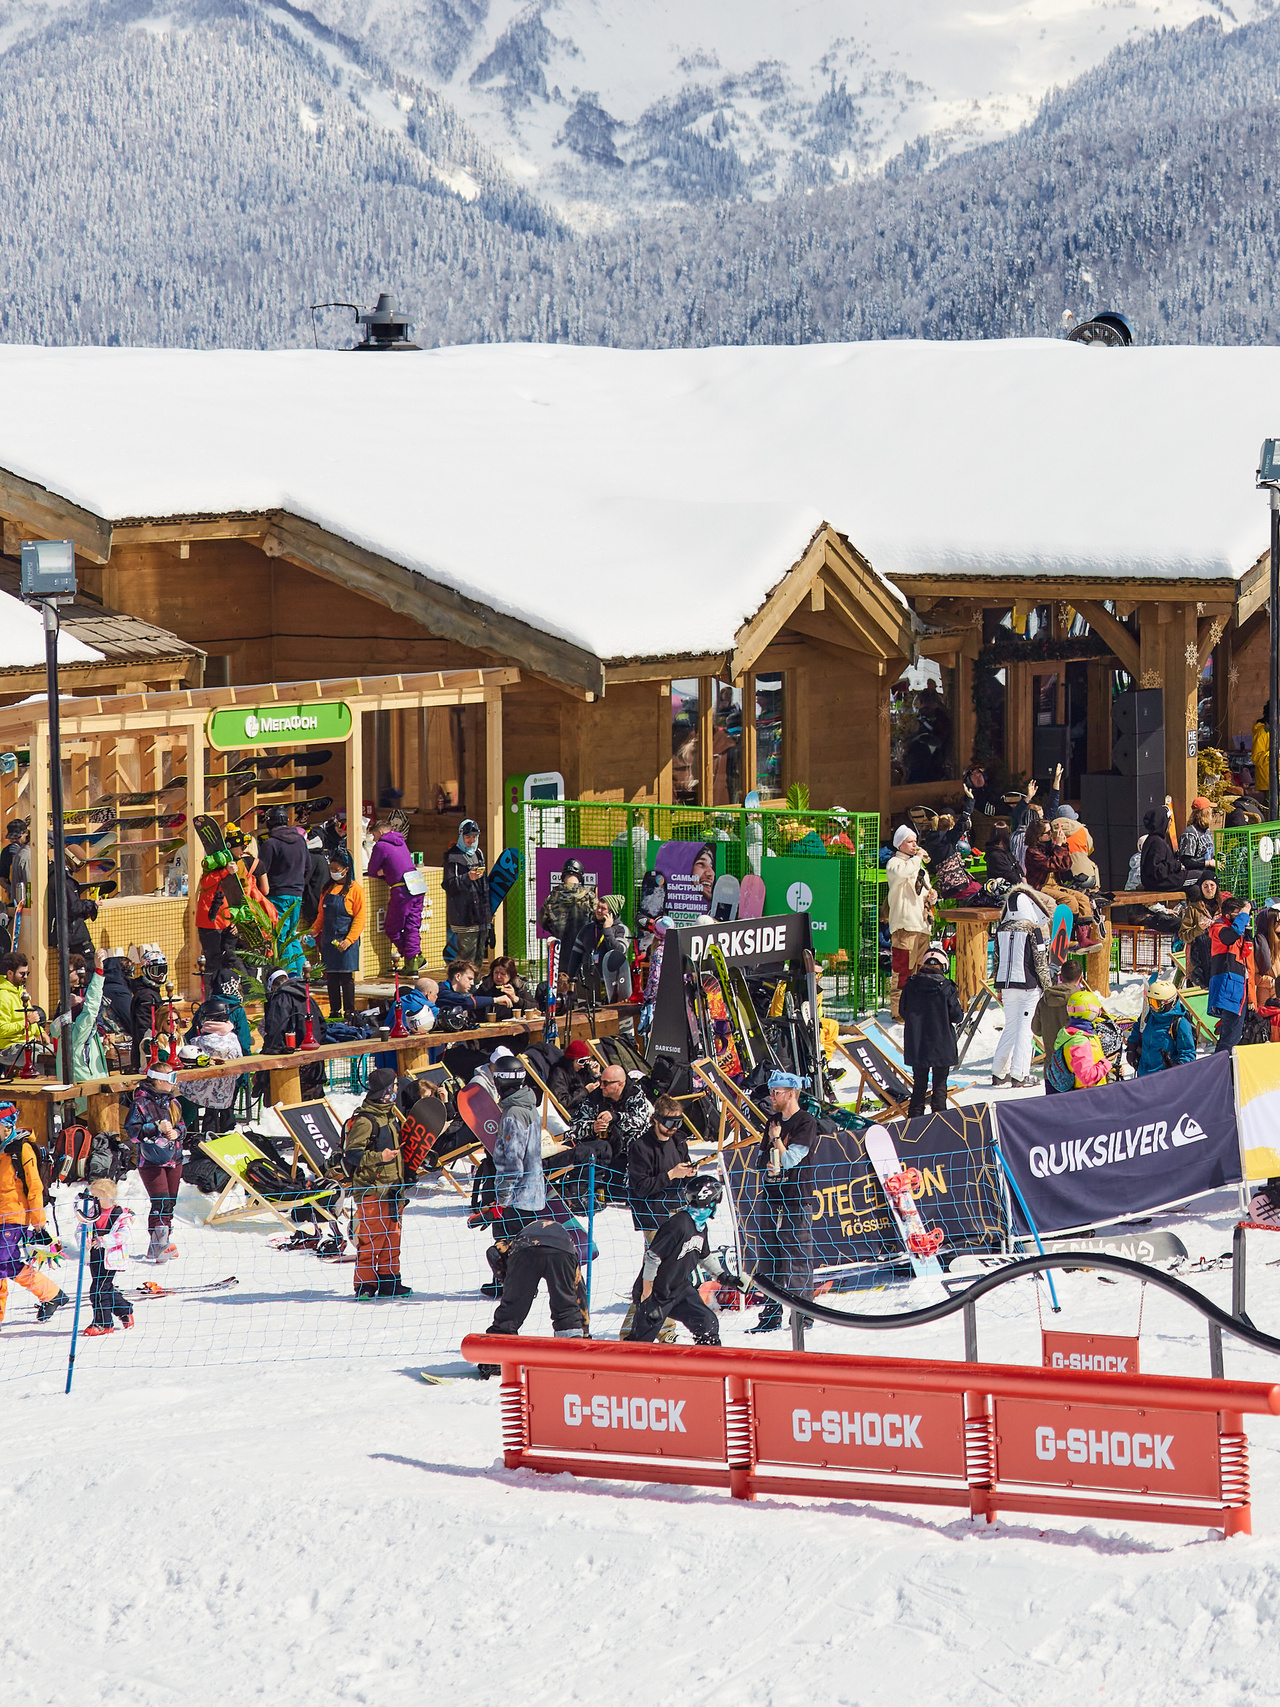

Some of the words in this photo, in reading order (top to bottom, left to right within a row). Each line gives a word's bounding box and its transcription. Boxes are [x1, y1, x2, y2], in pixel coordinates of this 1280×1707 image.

[670, 873, 700, 882] САМЫЙ
[666, 883, 704, 892] БЫСТРЫЙ
[667, 892, 703, 901] ИНТЕРНЕТ
[673, 902, 708, 911] ВЕРШИНЕ
[669, 911, 700, 920] ПОТОМУ
[691, 925, 787, 962] DARKSIDE
[655, 1044, 681, 1053] DARKSIDE
[1029, 1120, 1170, 1179] QUIKSILVER
[1051, 1351, 1129, 1374] G-SHOCK
[563, 1393, 688, 1434] G-SHOCK
[792, 1408, 925, 1450] G-SHOCK
[1034, 1425, 1175, 1471] G-SHOCK
